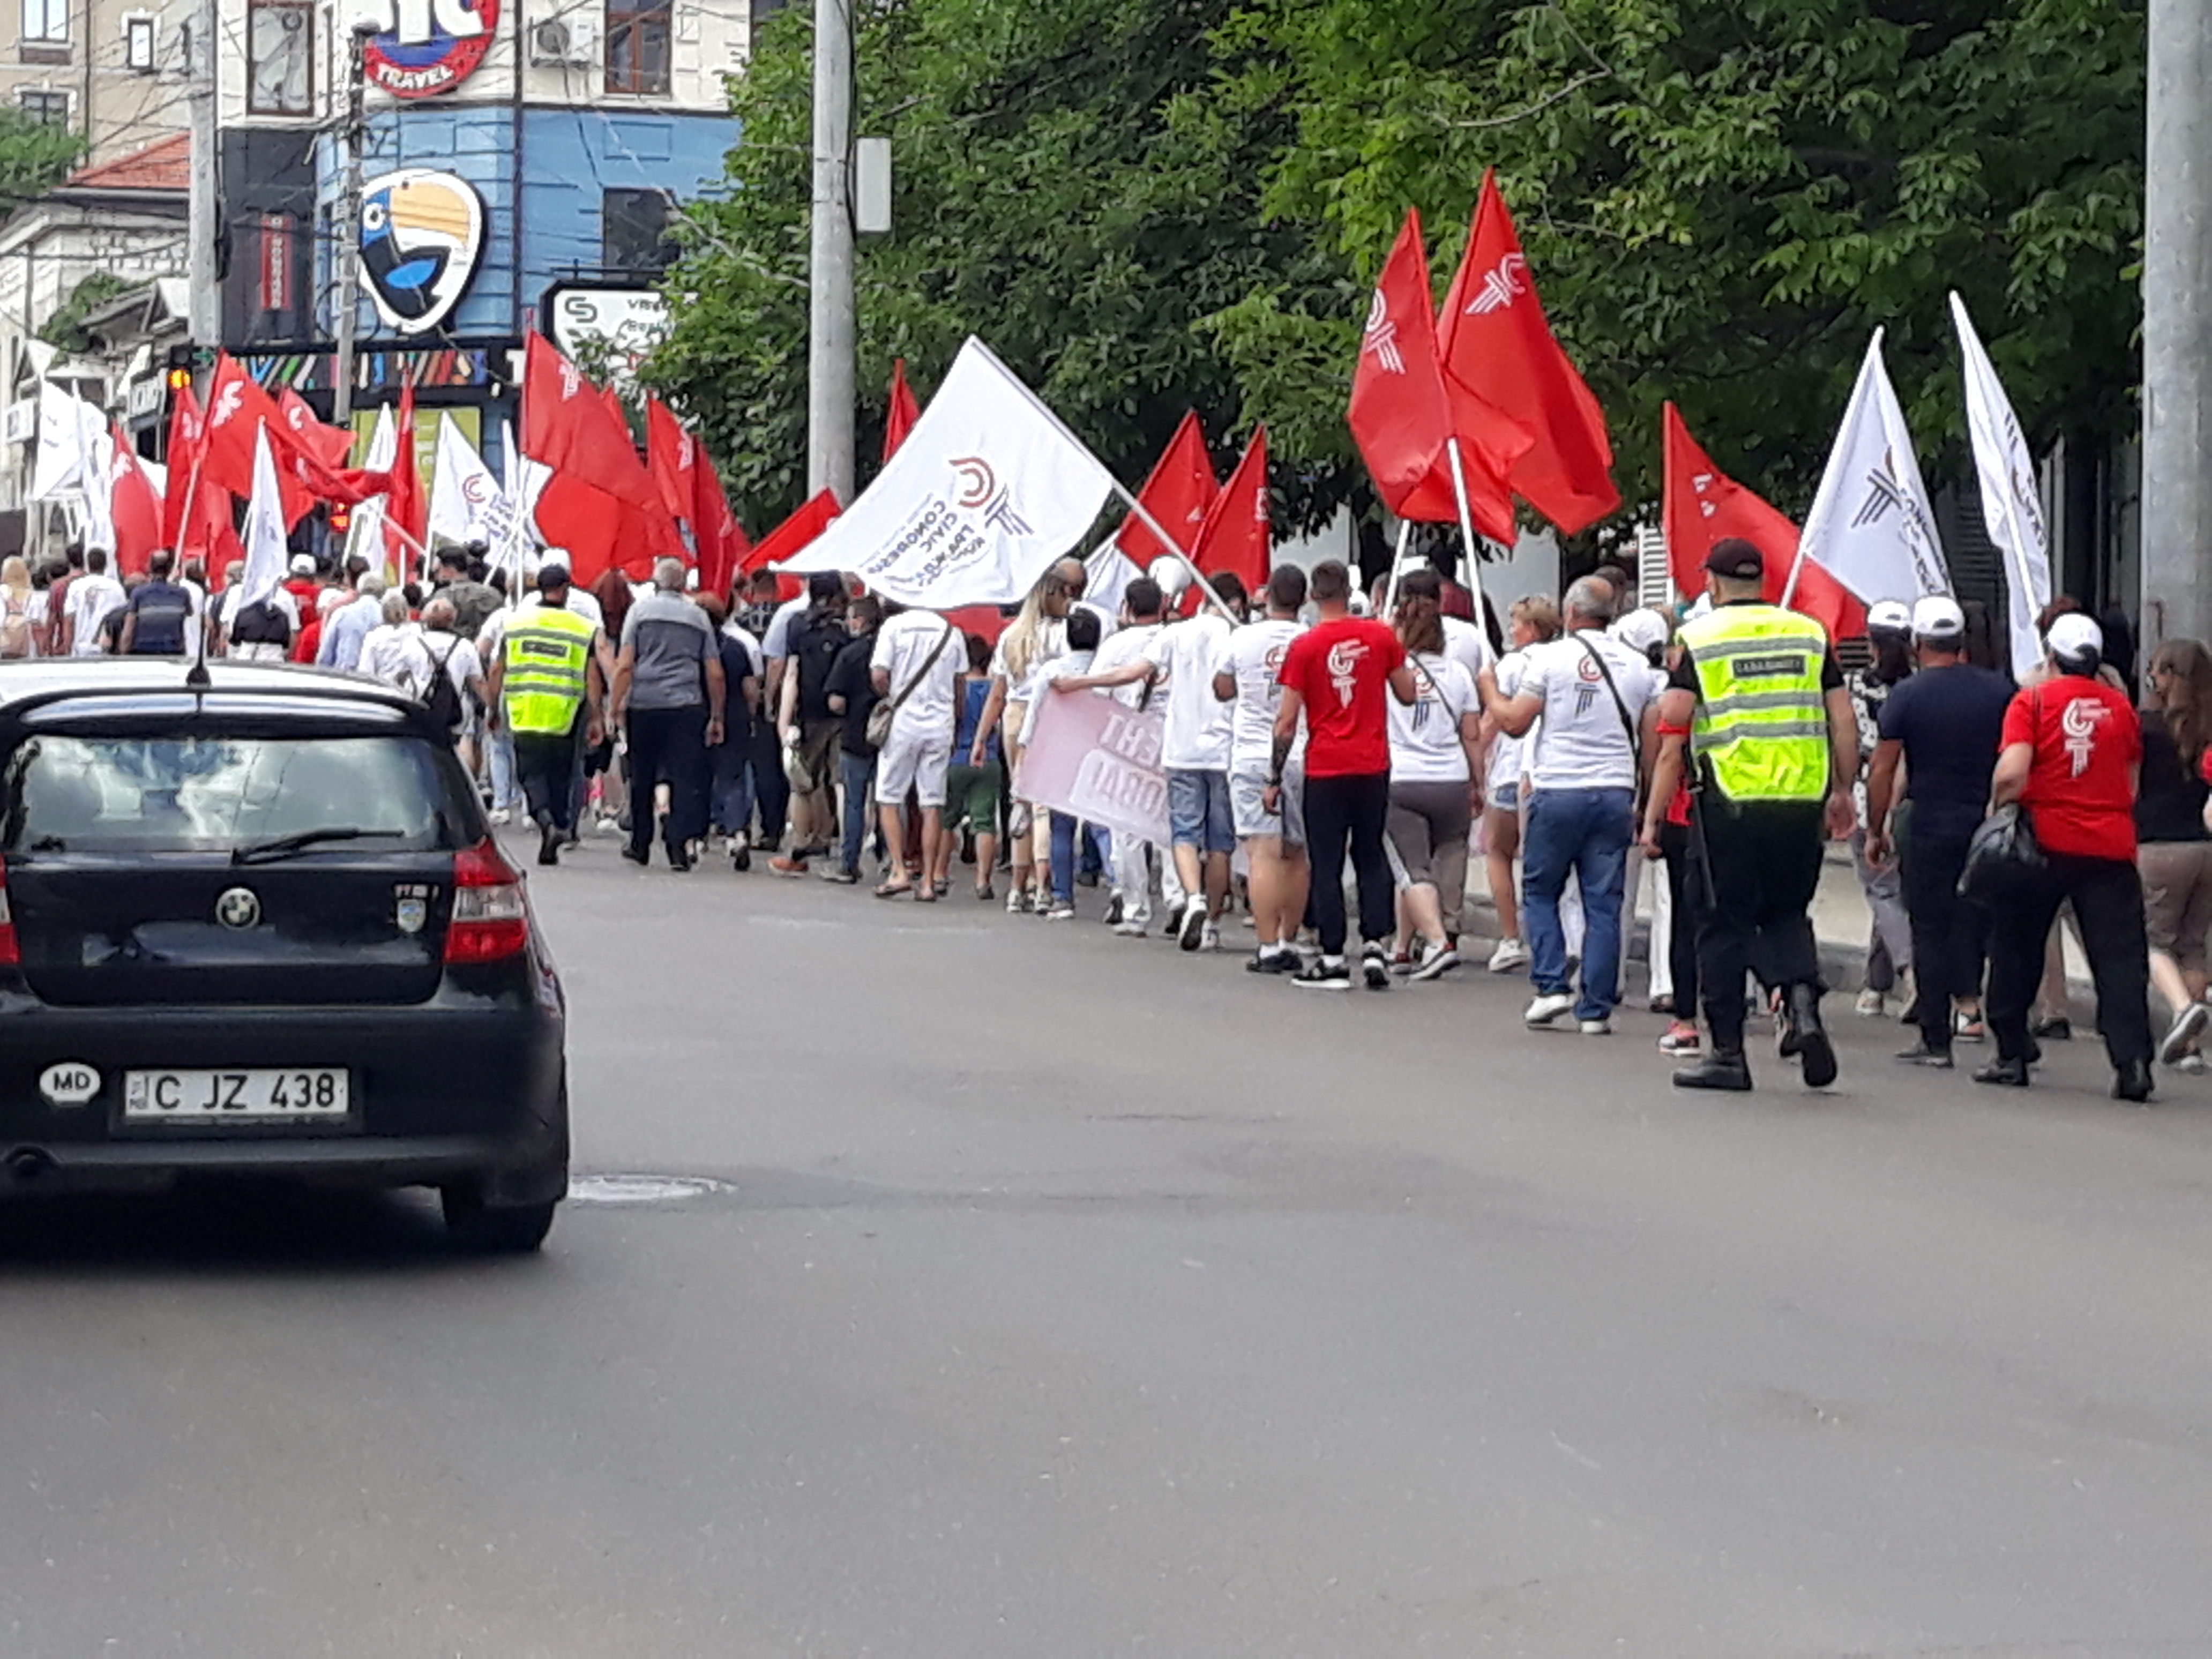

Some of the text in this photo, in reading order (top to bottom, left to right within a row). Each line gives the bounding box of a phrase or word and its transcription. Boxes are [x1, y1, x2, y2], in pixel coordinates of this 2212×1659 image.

[377, 63, 454, 90] TRAVEL
[54, 1071, 91, 1091] MD
[155, 1073, 334, 1110] C JZ 438
